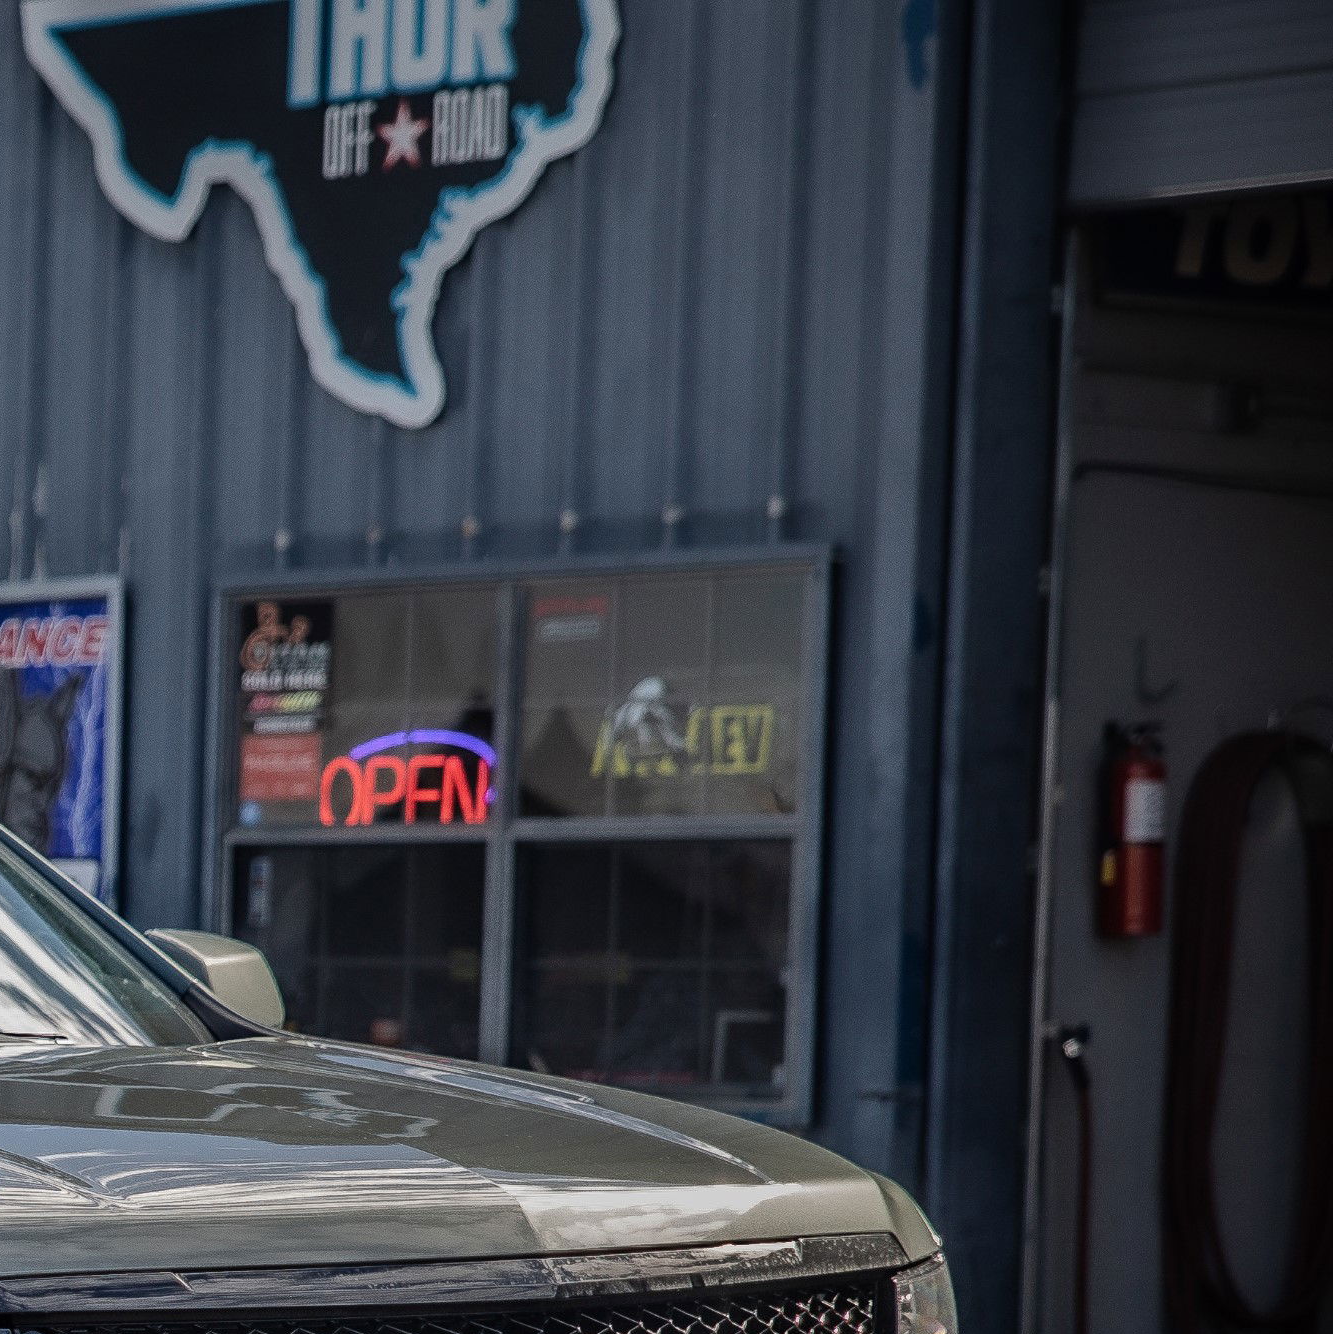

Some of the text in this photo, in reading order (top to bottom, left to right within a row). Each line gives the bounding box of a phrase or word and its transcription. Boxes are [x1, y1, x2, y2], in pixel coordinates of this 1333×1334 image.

[286, 0, 519, 110] THOR
[322, 83, 509, 180] OFF ROAD
[319, 753, 493, 826] OPEN
